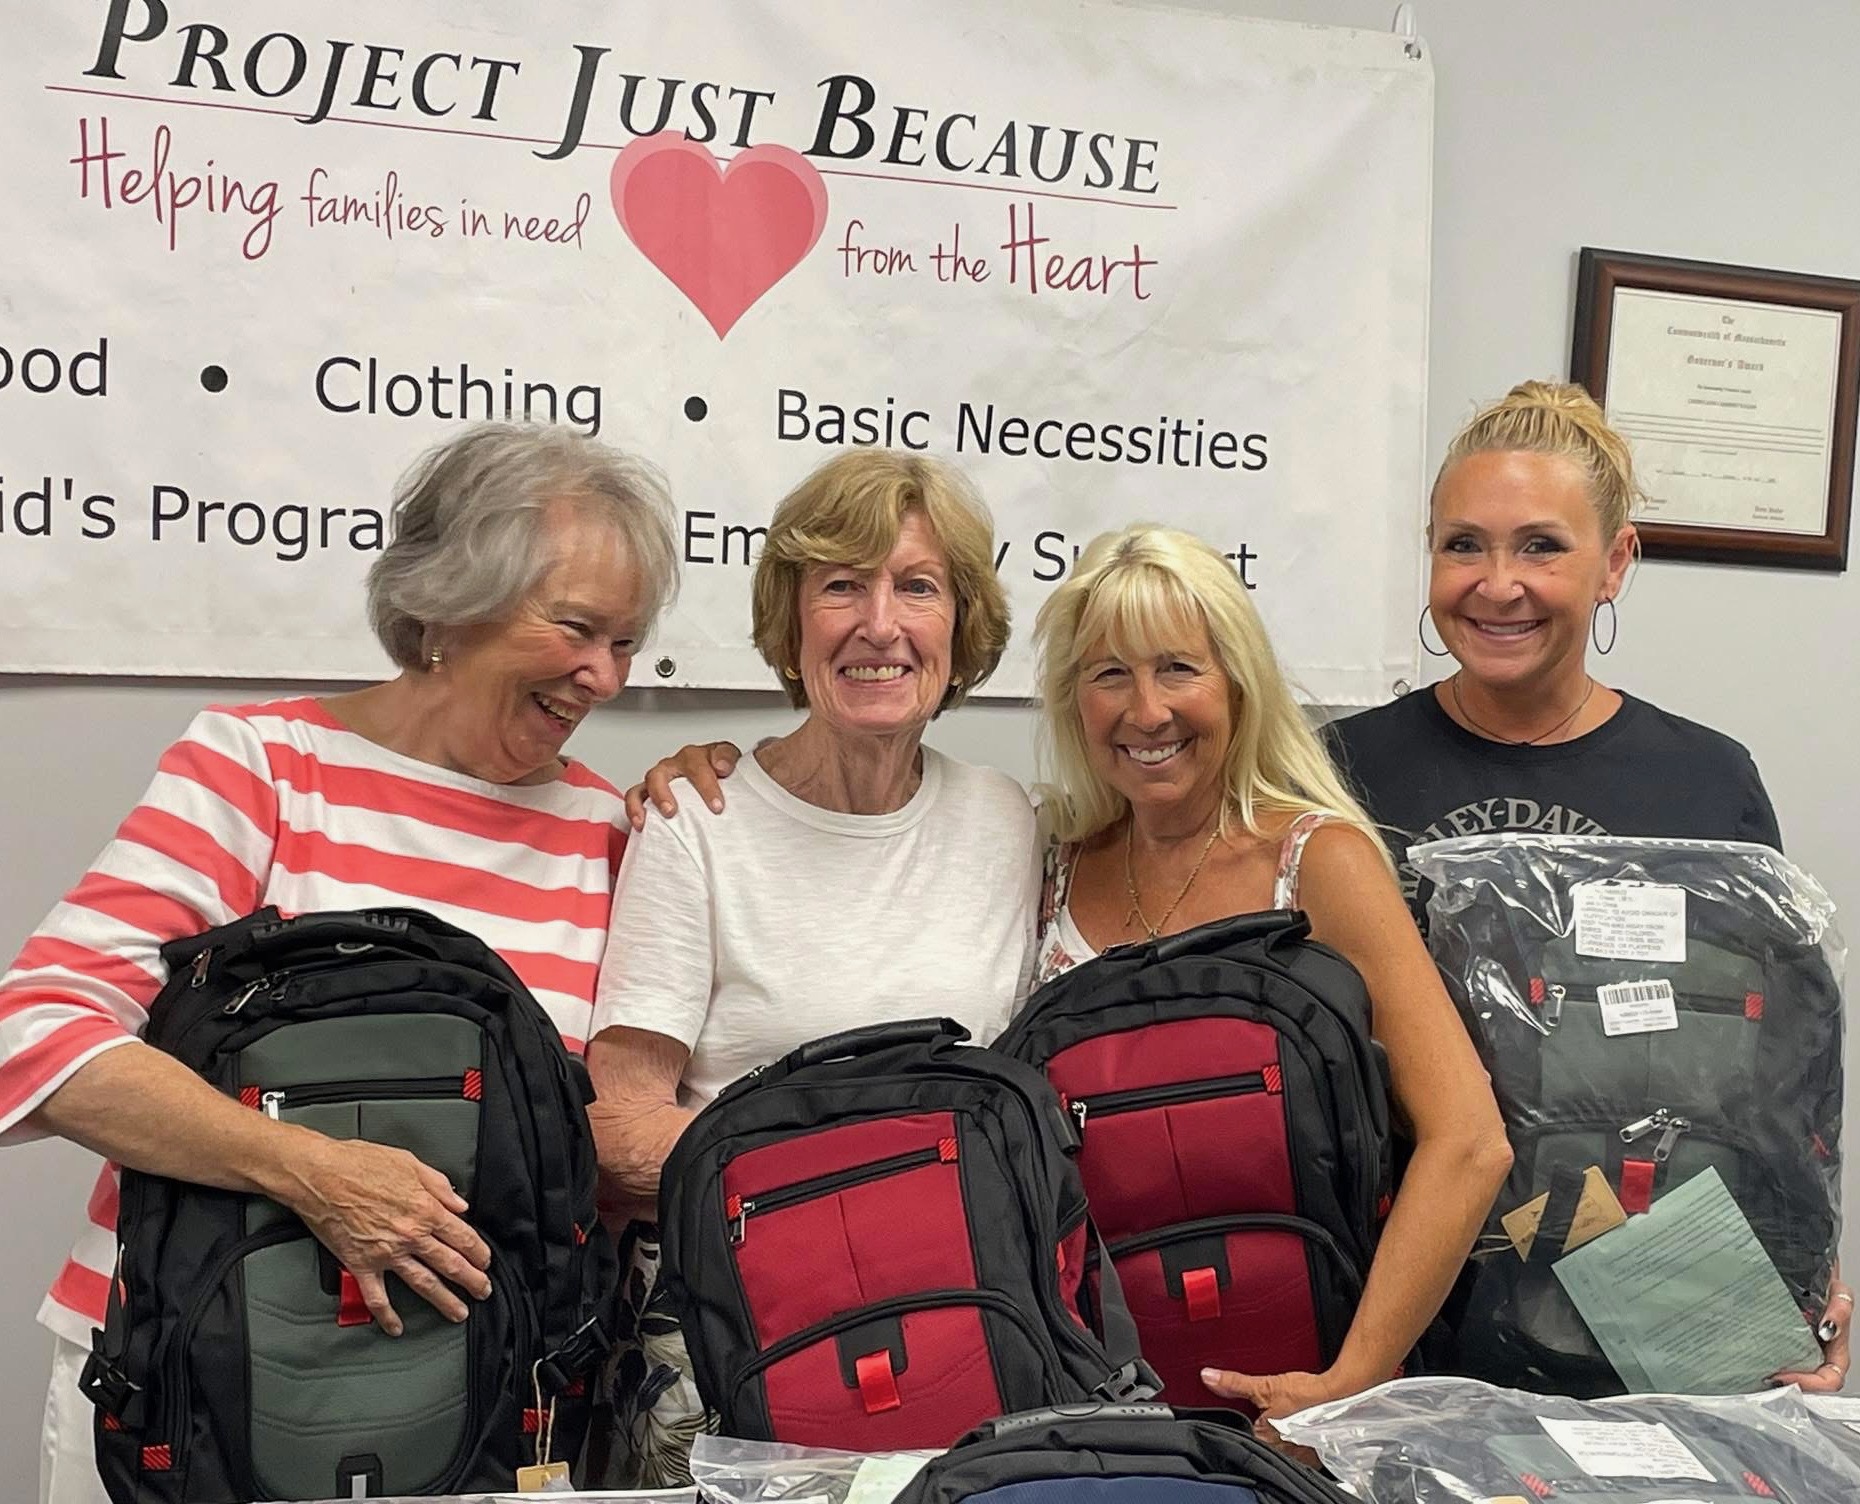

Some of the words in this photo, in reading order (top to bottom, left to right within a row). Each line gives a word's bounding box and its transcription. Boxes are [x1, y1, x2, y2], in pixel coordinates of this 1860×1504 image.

[82, 0, 520, 126] PROJECT
[532, 44, 776, 161] JUST
[802, 74, 1161, 196] BECAUSE
[70, 116, 284, 261] Helping
[300, 167, 449, 241] families
[461, 199, 492, 237] in
[504, 192, 592, 251] need
[837, 220, 918, 278] from
[929, 222, 992, 284] the
[1000, 202, 1159, 301] Heart
[315, 356, 602, 438] Clothing
[778, 388, 931, 450] Basic
[956, 402, 1268, 471] Necessities
[152, 484, 385, 562] Progra
